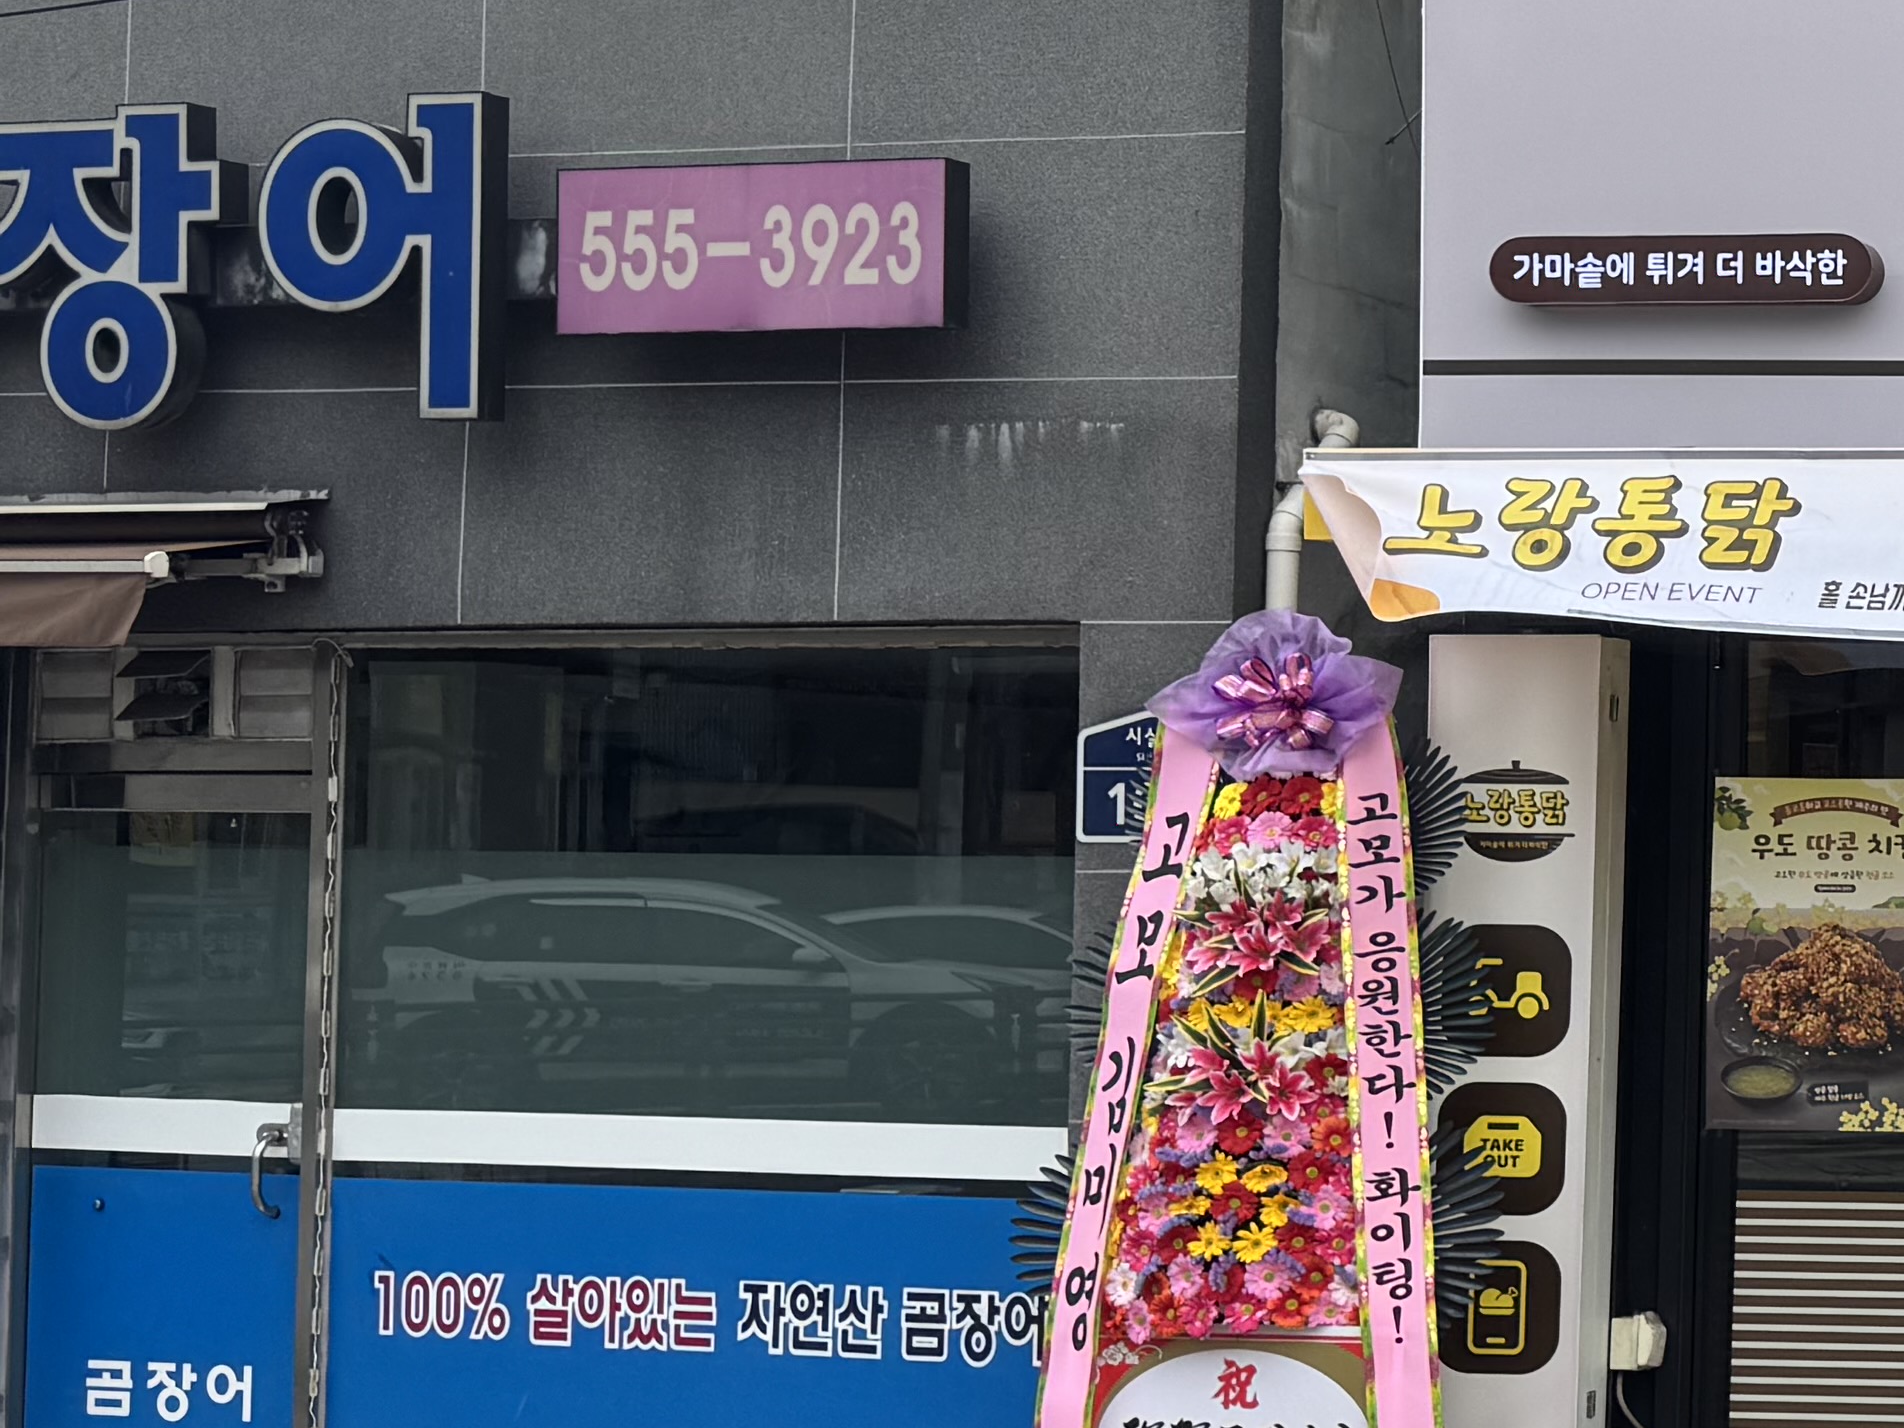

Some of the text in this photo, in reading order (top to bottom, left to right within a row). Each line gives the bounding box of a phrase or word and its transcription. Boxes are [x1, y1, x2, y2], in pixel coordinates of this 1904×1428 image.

[578, 200, 923, 293] 555-3923
[1512, 248, 1848, 290] 가마솥에 튀겨 더 바삭한
[1382, 474, 1802, 573] 노랑통닭
[1581, 582, 1763, 605] OPEN EVENT
[1817, 580, 1843, 609] 홀
[1463, 789, 1570, 828] 노랑통닭
[1751, 833, 1797, 860] 우도
[1806, 831, 1859, 862] 땅콩
[1115, 812, 1190, 984] 고모
[1346, 793, 1421, 1345] 고모가 응원한다! 화이팅!
[1480, 1138, 1524, 1152] TAKE
[372, 1270, 508, 1341] 100%
[527, 1273, 716, 1352] 살아있는
[736, 1279, 887, 1360] 자연산
[85, 1359, 254, 1424] 곰장어
[1212, 1357, 1260, 1411] 祝
